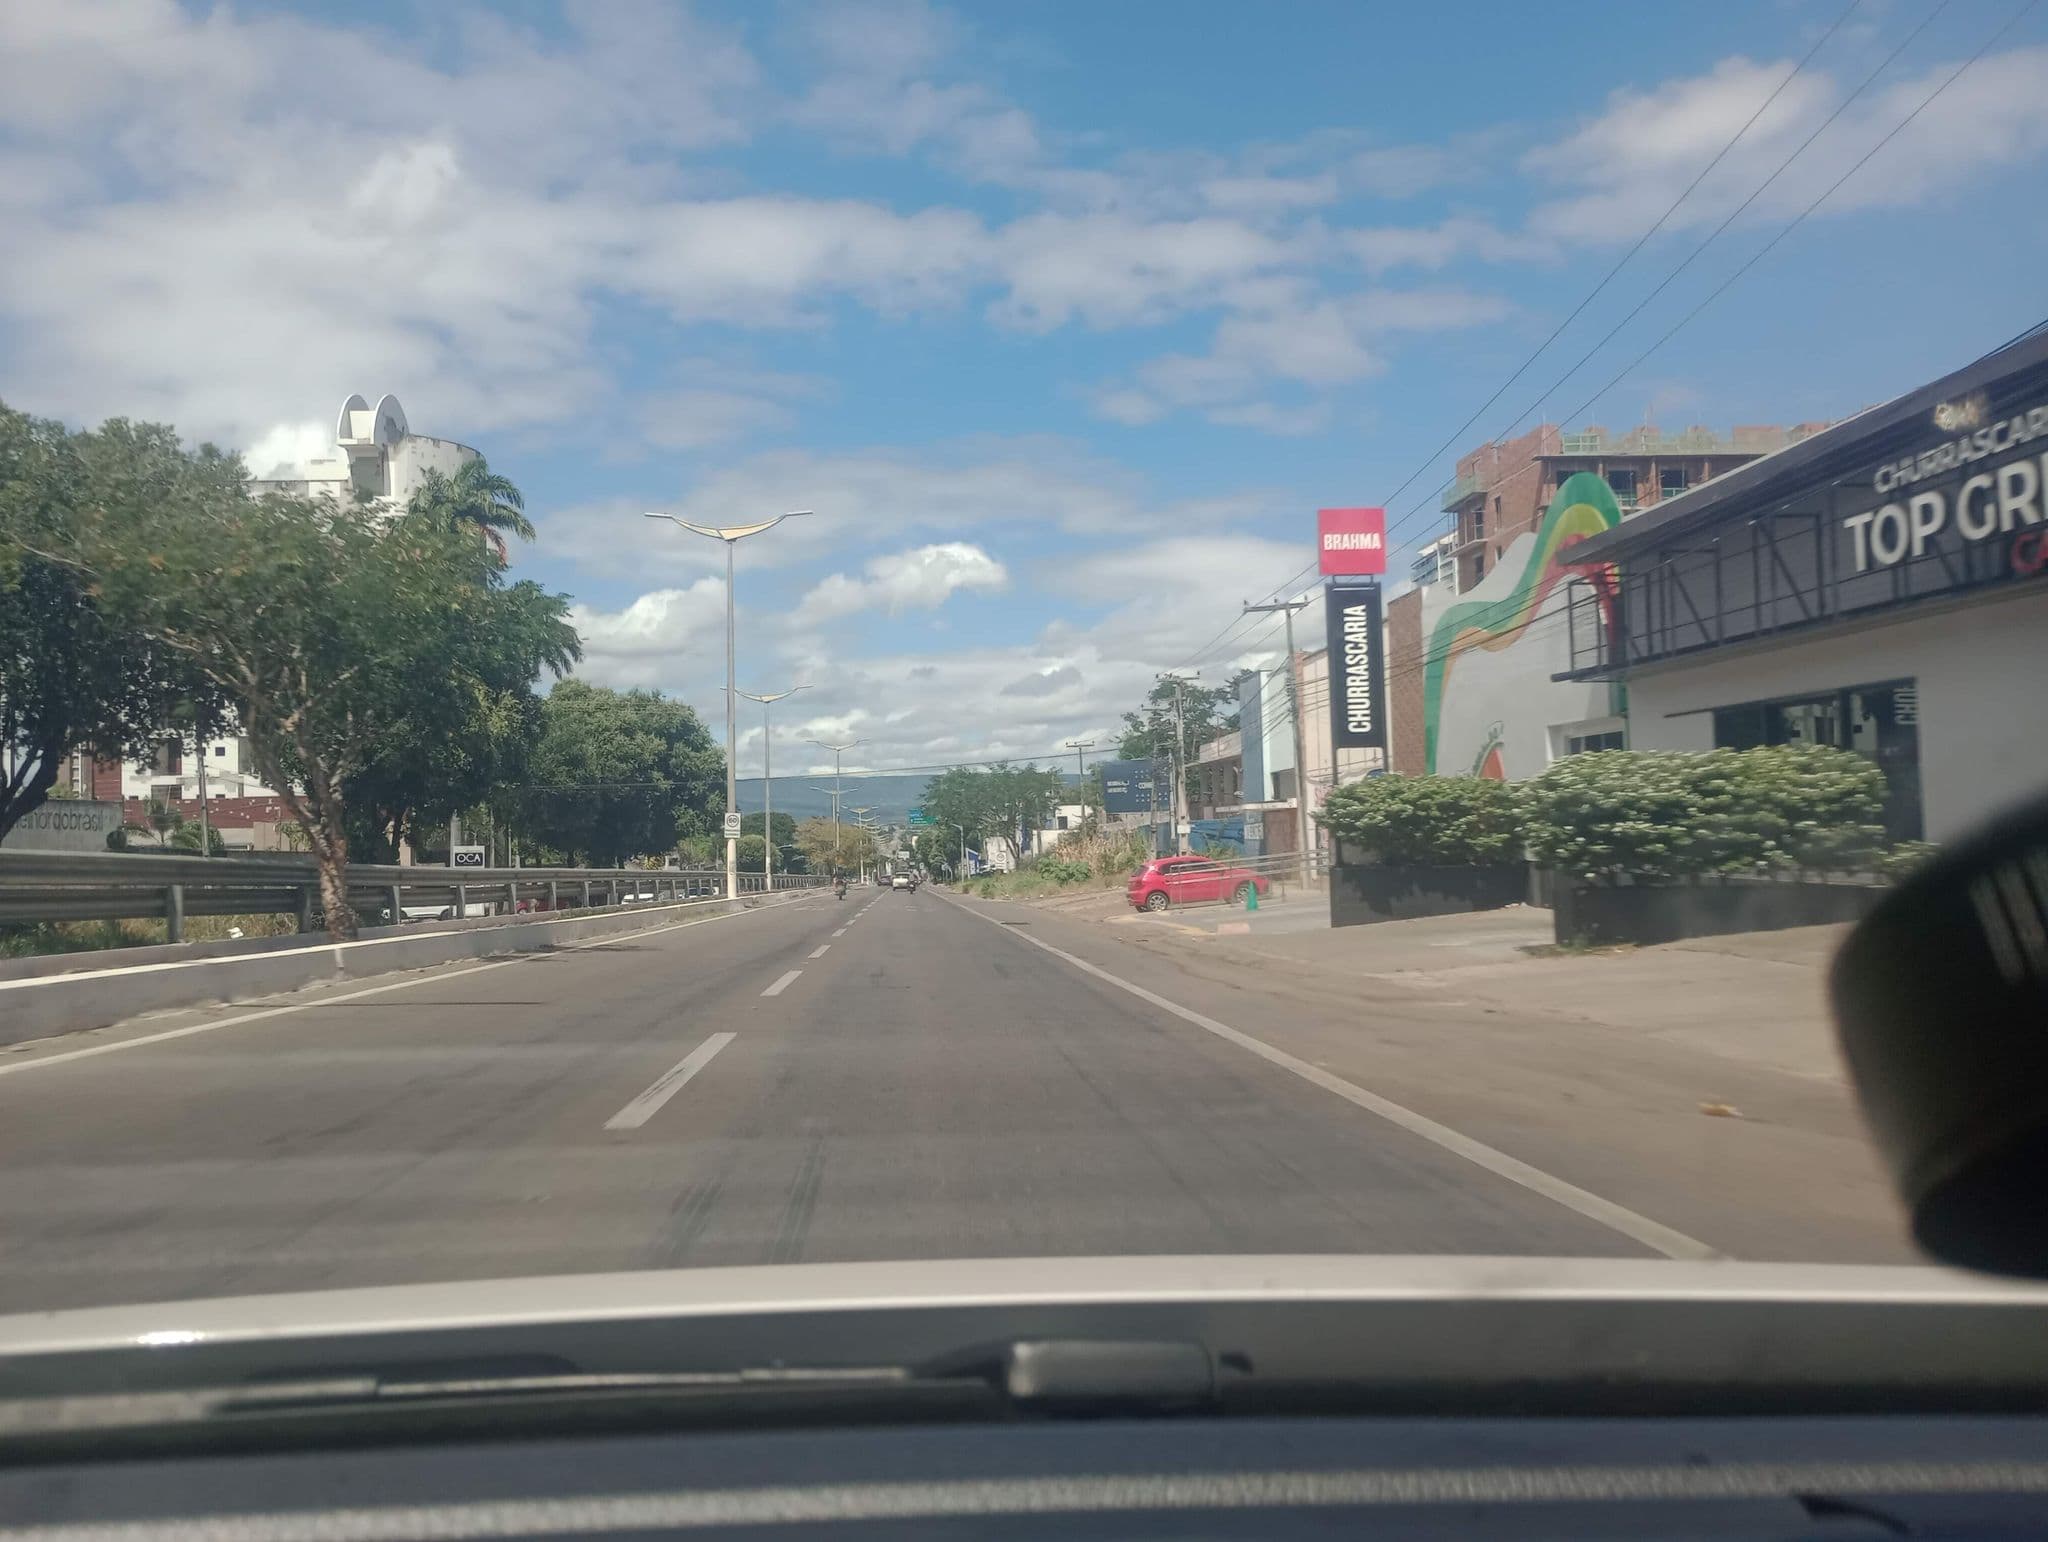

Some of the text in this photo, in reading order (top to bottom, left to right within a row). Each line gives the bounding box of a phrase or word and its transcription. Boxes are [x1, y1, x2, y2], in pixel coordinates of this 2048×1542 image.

[1324, 533, 1381, 550] BRAHMA
[1843, 490, 1946, 572] TOP
[1342, 604, 1372, 734] CHURRASCARIA
[457, 854, 480, 862] OCA
